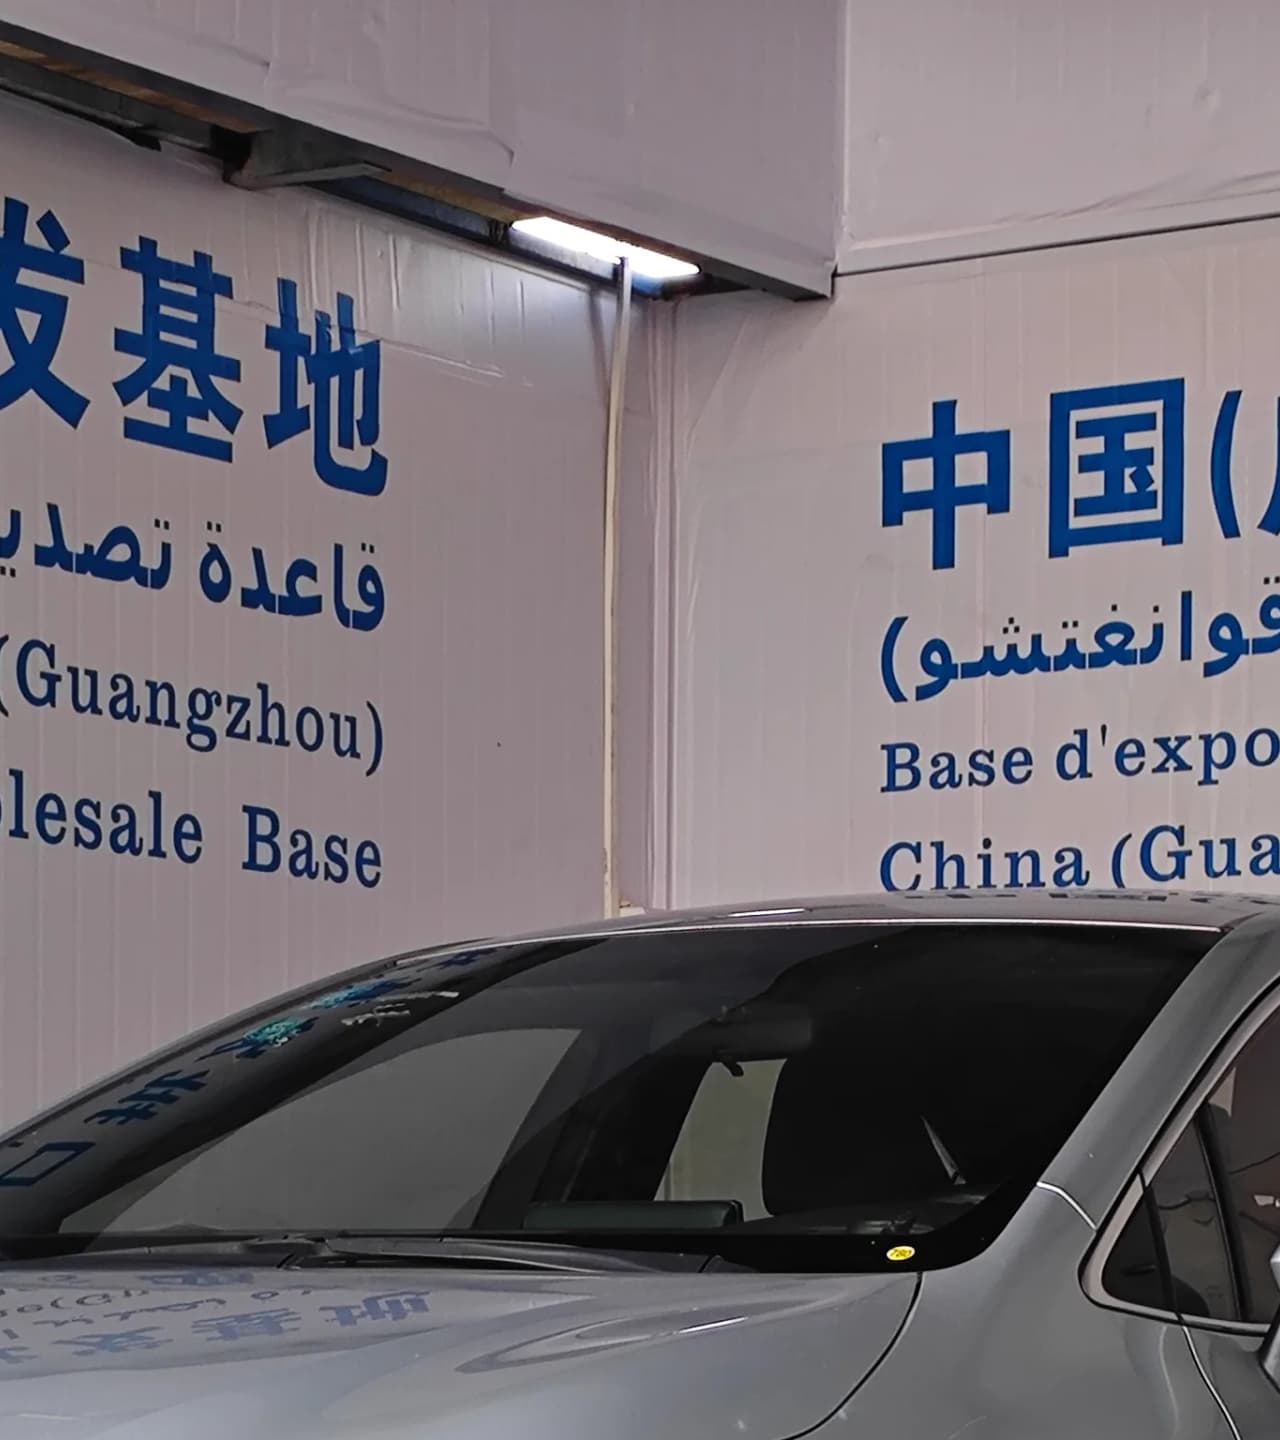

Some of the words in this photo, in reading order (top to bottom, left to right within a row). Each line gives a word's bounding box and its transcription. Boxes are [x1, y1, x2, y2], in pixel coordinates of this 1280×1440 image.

[200, 521, 385, 632] قاعدة
[880, 741, 1033, 793] Base
[242, 803, 383, 889] Base
[880, 837, 1090, 893] China
